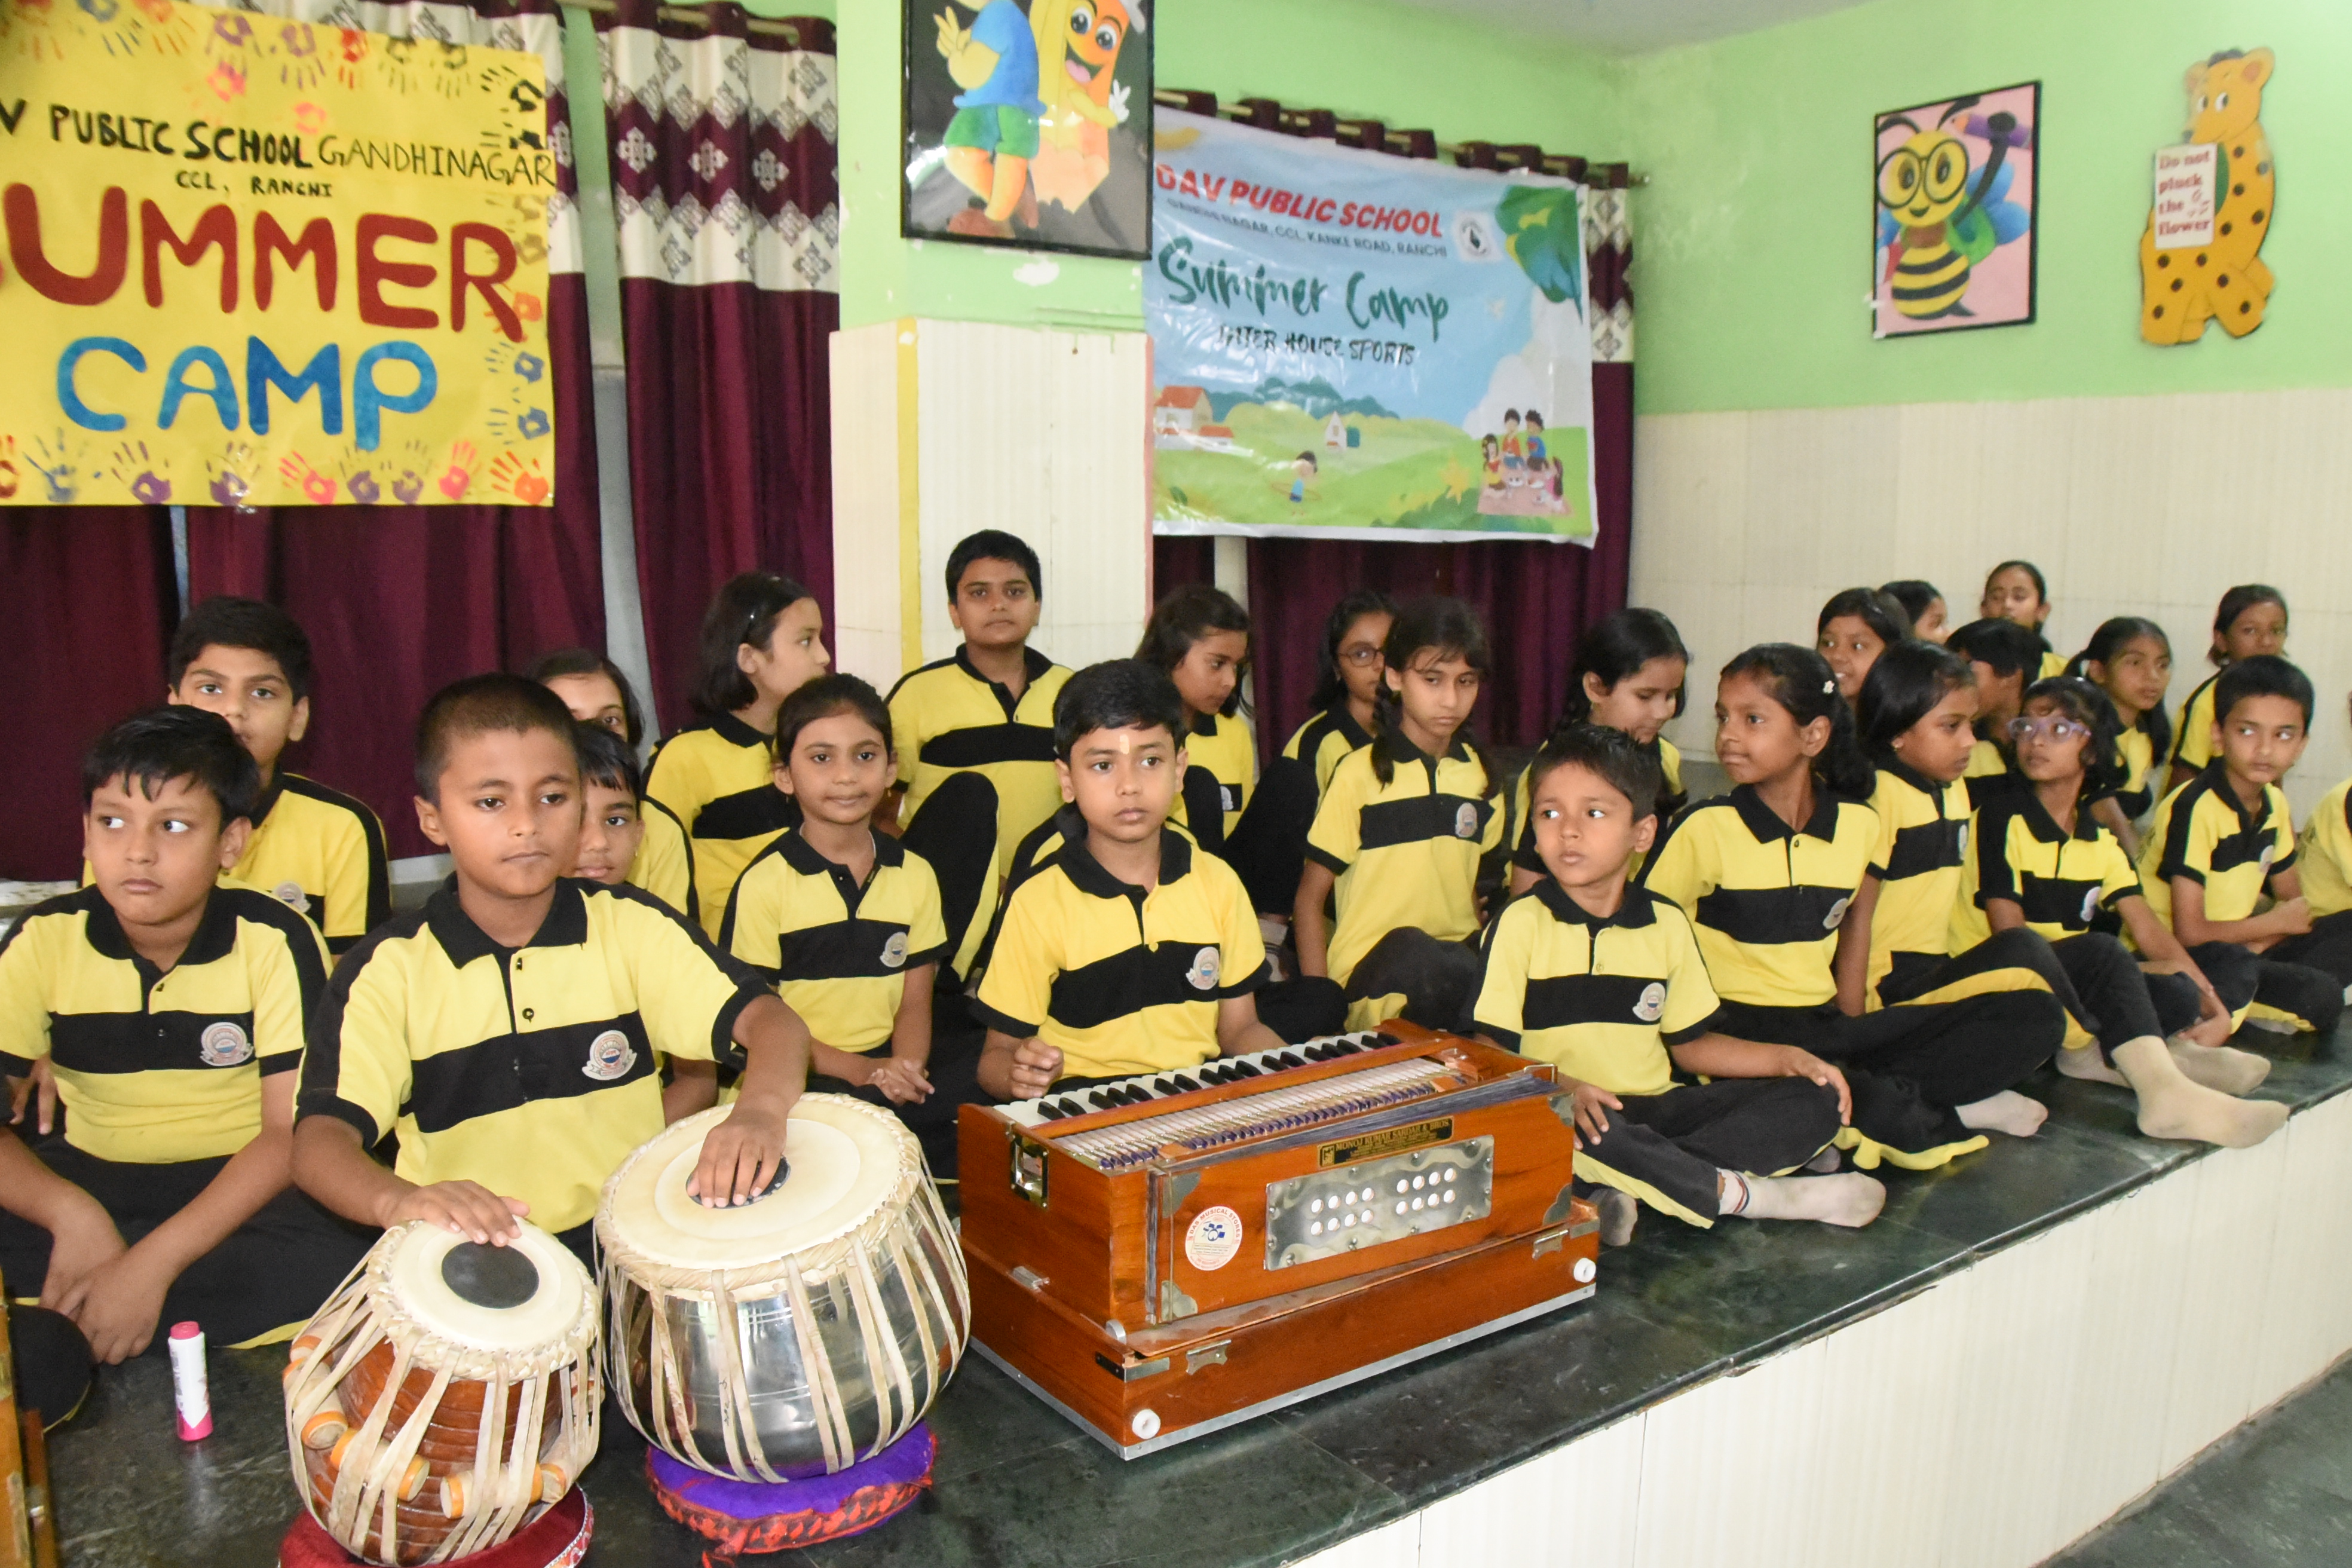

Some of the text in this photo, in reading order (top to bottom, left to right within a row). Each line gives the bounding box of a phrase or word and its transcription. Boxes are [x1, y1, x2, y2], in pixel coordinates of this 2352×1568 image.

[49, 104, 174, 155] PUBLIC
[183, 121, 313, 169] SCHOOL
[318, 135, 556, 186] GANDHINAGAR
[1156, 164, 1226, 202] DAV
[1229, 179, 1337, 223] PUBLIC
[1339, 201, 1443, 238] SCHOOL
[1158, 235, 1450, 343] Summer Camp
[1348, 338, 1416, 366] SPORTS
[57, 335, 438, 452] CAMP
[1189, 1220, 1199, 1235] DAS
[1200, 1208, 1228, 1220] MUSICAL
[1229, 1212, 1241, 1238] STORES
